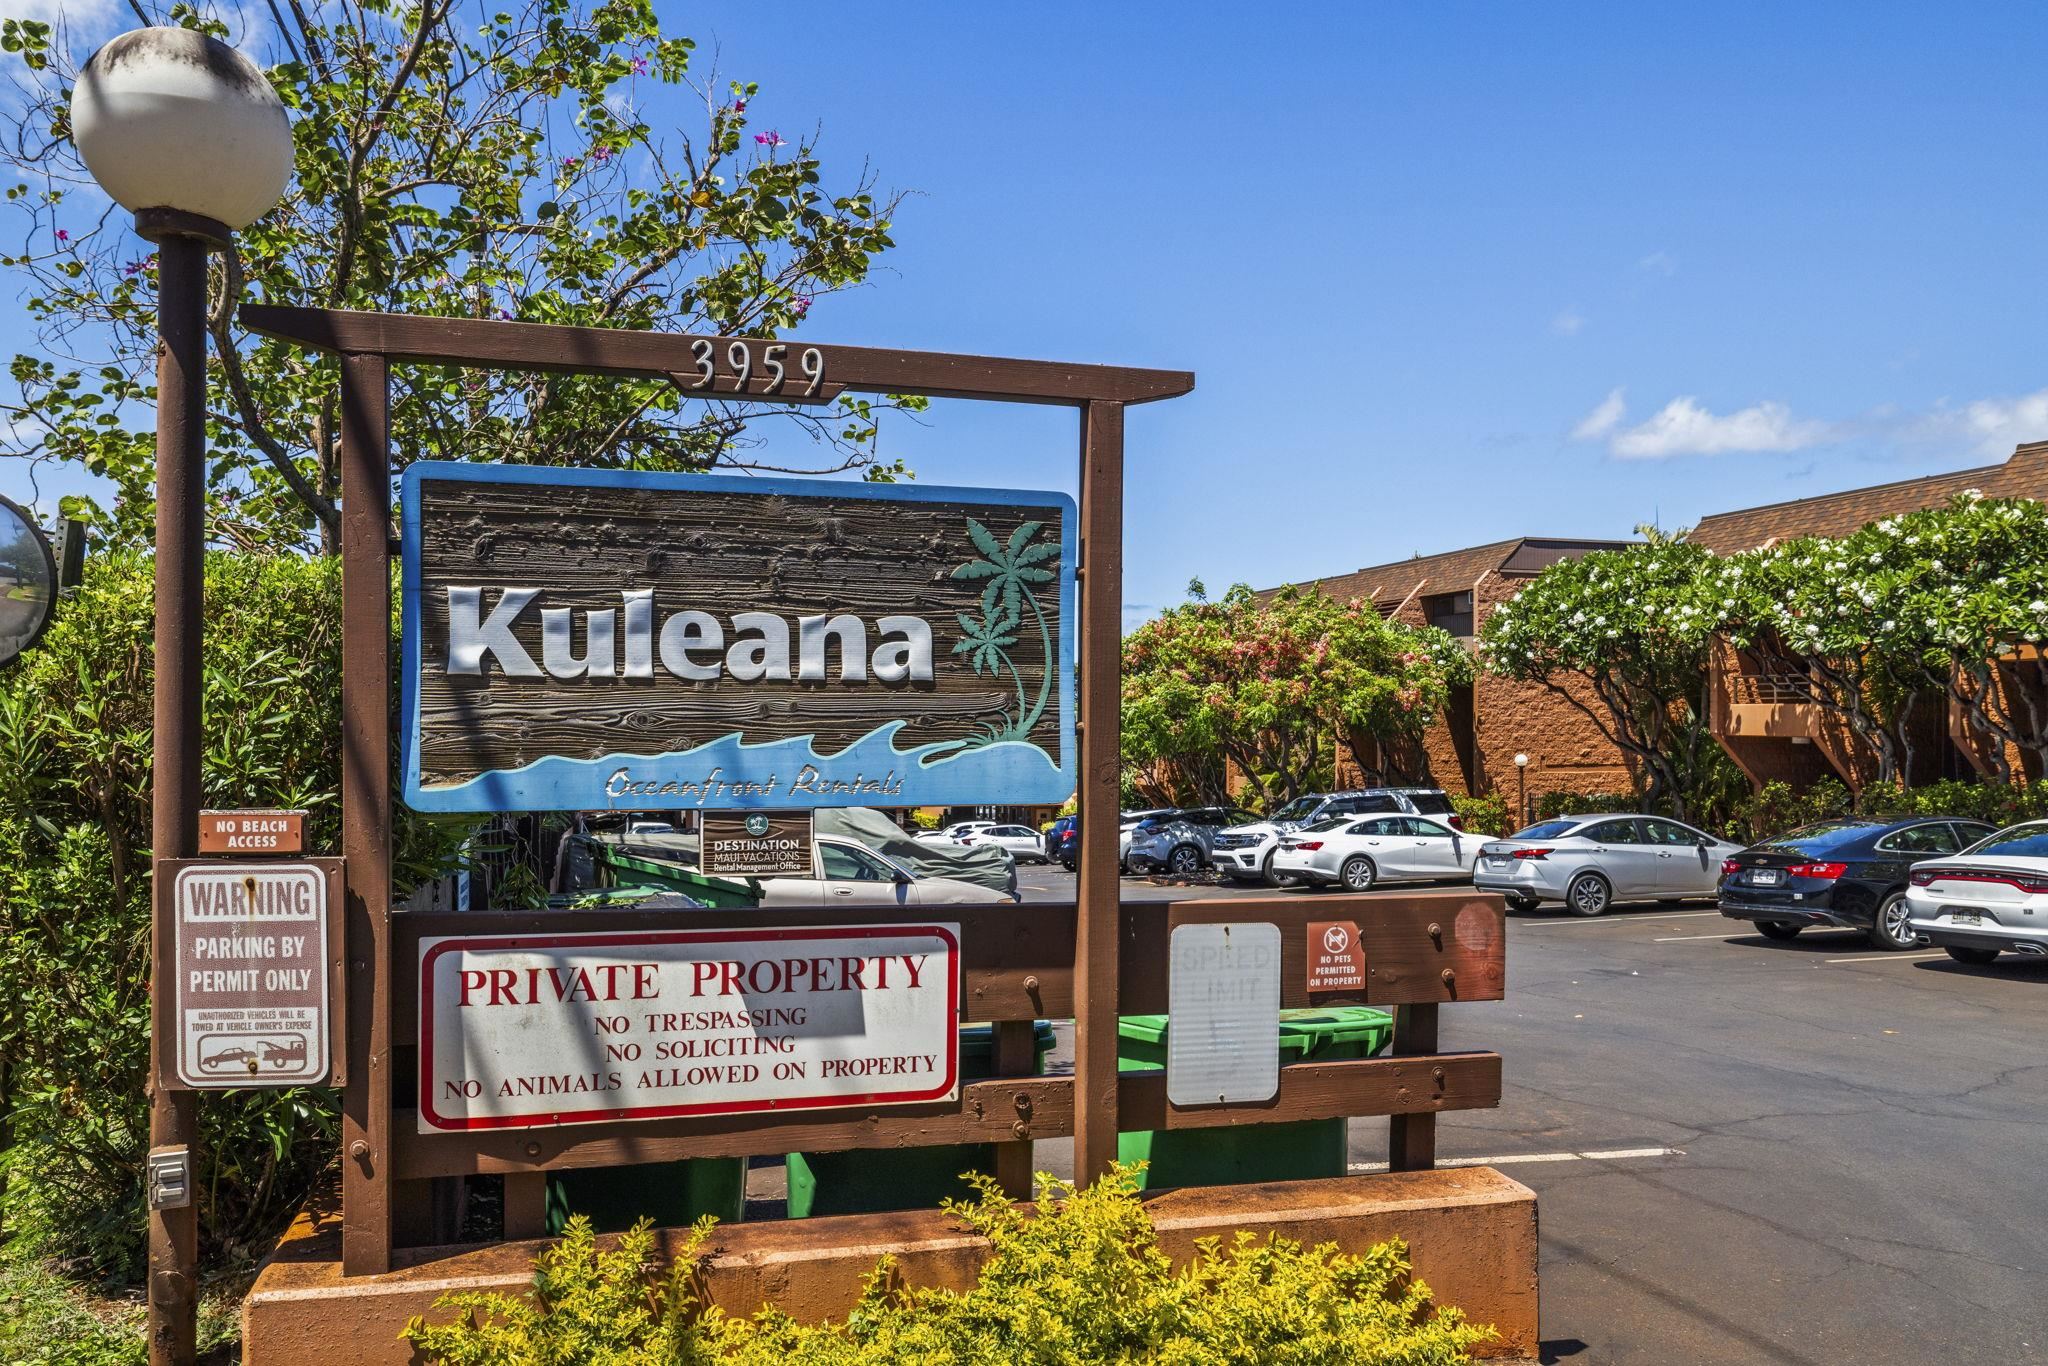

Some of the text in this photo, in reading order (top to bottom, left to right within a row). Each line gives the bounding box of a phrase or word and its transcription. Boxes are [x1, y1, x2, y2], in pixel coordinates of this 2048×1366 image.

[691, 339, 823, 397] 3959
[446, 585, 935, 682] Kuleana
[605, 763, 905, 806] Oceanfront Rentals
[216, 820, 288, 833] NO BEACH
[227, 835, 277, 848] ACCESS
[714, 839, 800, 851] DESTINATION
[713, 861, 801, 873] Rental Management Office
[714, 851, 800, 863] MAUI VACATIONS
[189, 880, 311, 917] WARNING
[195, 935, 305, 959] PARKING BY
[1183, 944, 1271, 972] SPEED
[1315, 965, 1356, 976] PERMITTED
[1320, 955, 1352, 964] NO PETS
[190, 968, 312, 993] PERMIT ONLY
[456, 954, 929, 1008] PRIVATE PROPERTY
[1310, 976, 1362, 987] ON PROPERTY
[192, 1020, 312, 1032] TOWED AT VEHICLE OWNER'S EXPENSE
[198, 1010, 305, 1021] UNAUTHORIZED VEHICLES WILL BE
[594, 1007, 807, 1036] NO TRESPASSING
[606, 1035, 796, 1062] NO SOLICITING
[444, 1054, 938, 1099] NO ANIMALS ALLOWED ON PROPERTY
